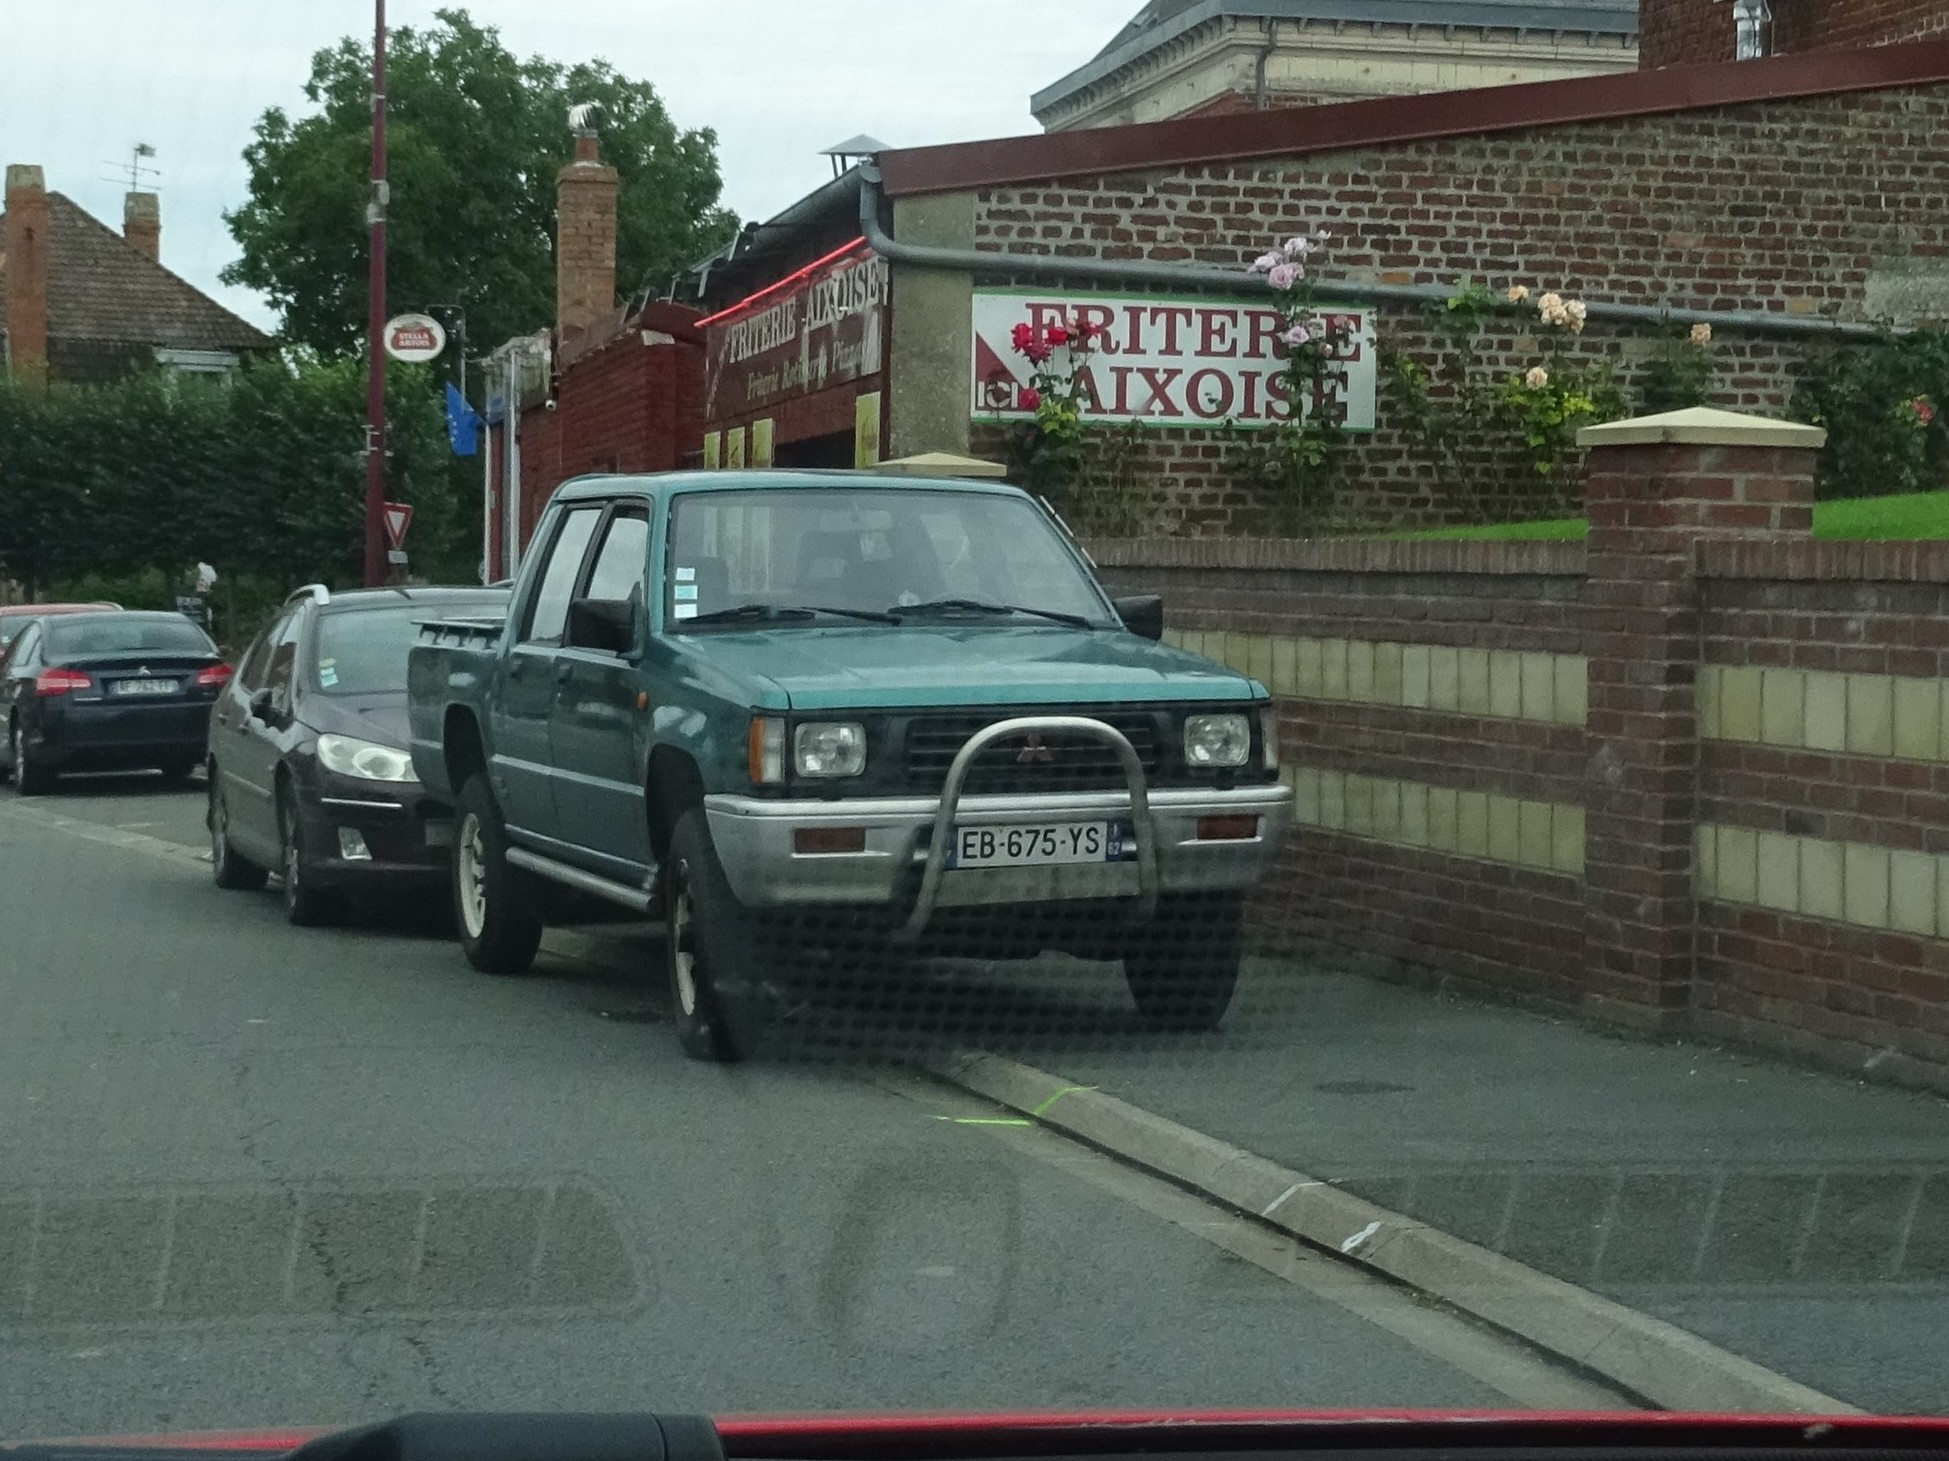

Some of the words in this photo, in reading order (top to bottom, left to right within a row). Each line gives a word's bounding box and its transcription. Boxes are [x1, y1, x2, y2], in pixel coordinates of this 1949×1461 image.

[728, 295, 797, 364] FRITERIE
[977, 380, 1019, 409] ICI
[961, 826, 1100, 860] EB-675-YS
